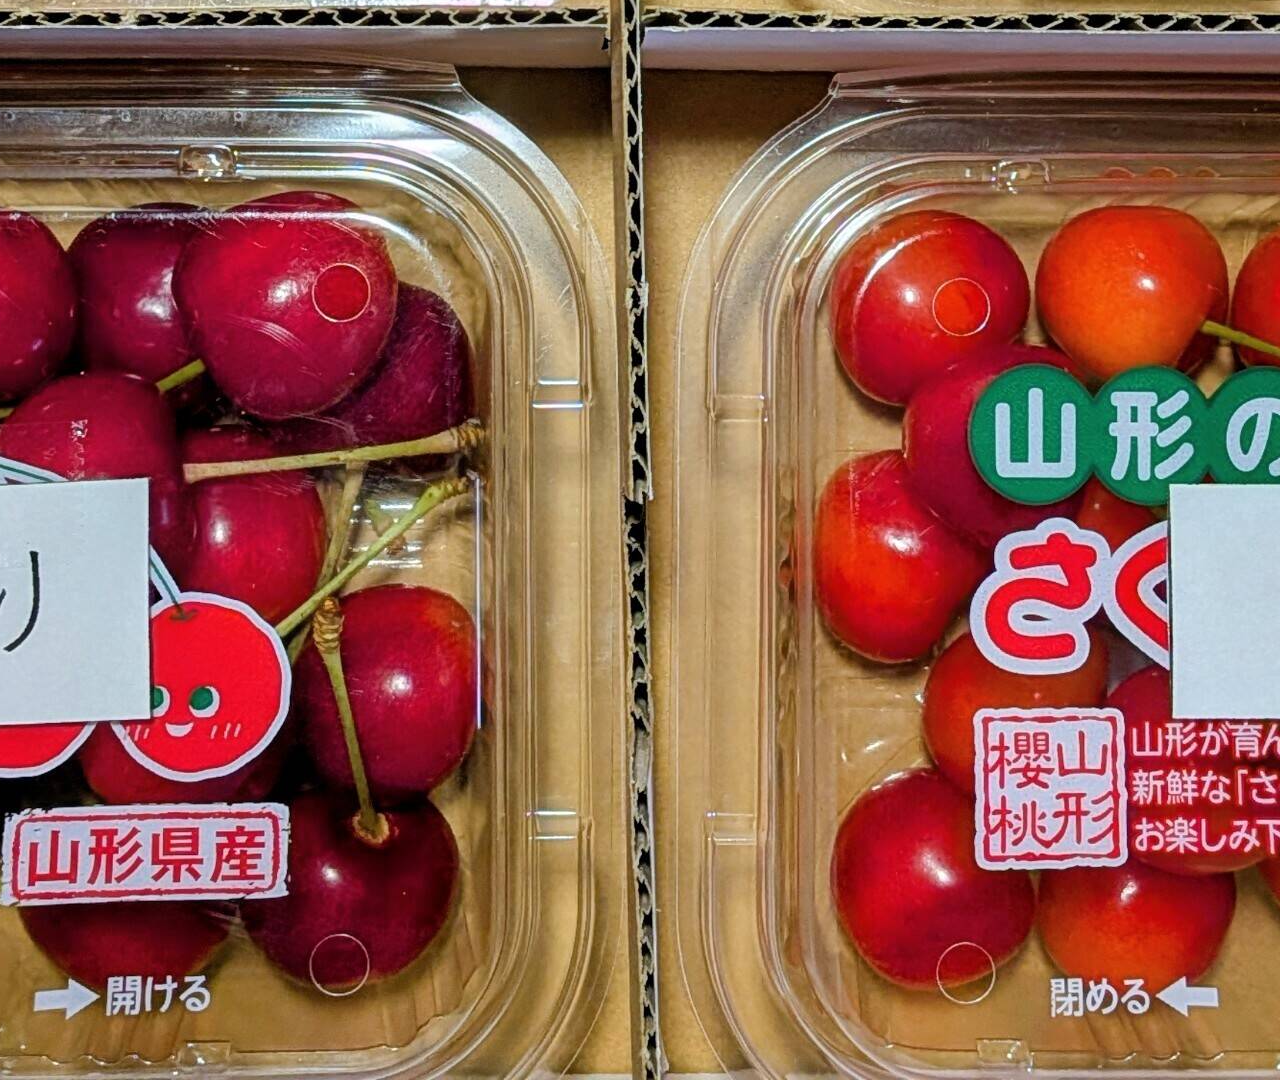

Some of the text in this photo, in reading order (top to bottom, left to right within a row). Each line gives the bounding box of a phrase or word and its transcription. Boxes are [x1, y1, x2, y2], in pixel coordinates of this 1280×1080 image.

[27, 825, 266, 886] 山形県産
[106, 975, 211, 1016] 開ける
[1050, 977, 1150, 1018] 閉める
